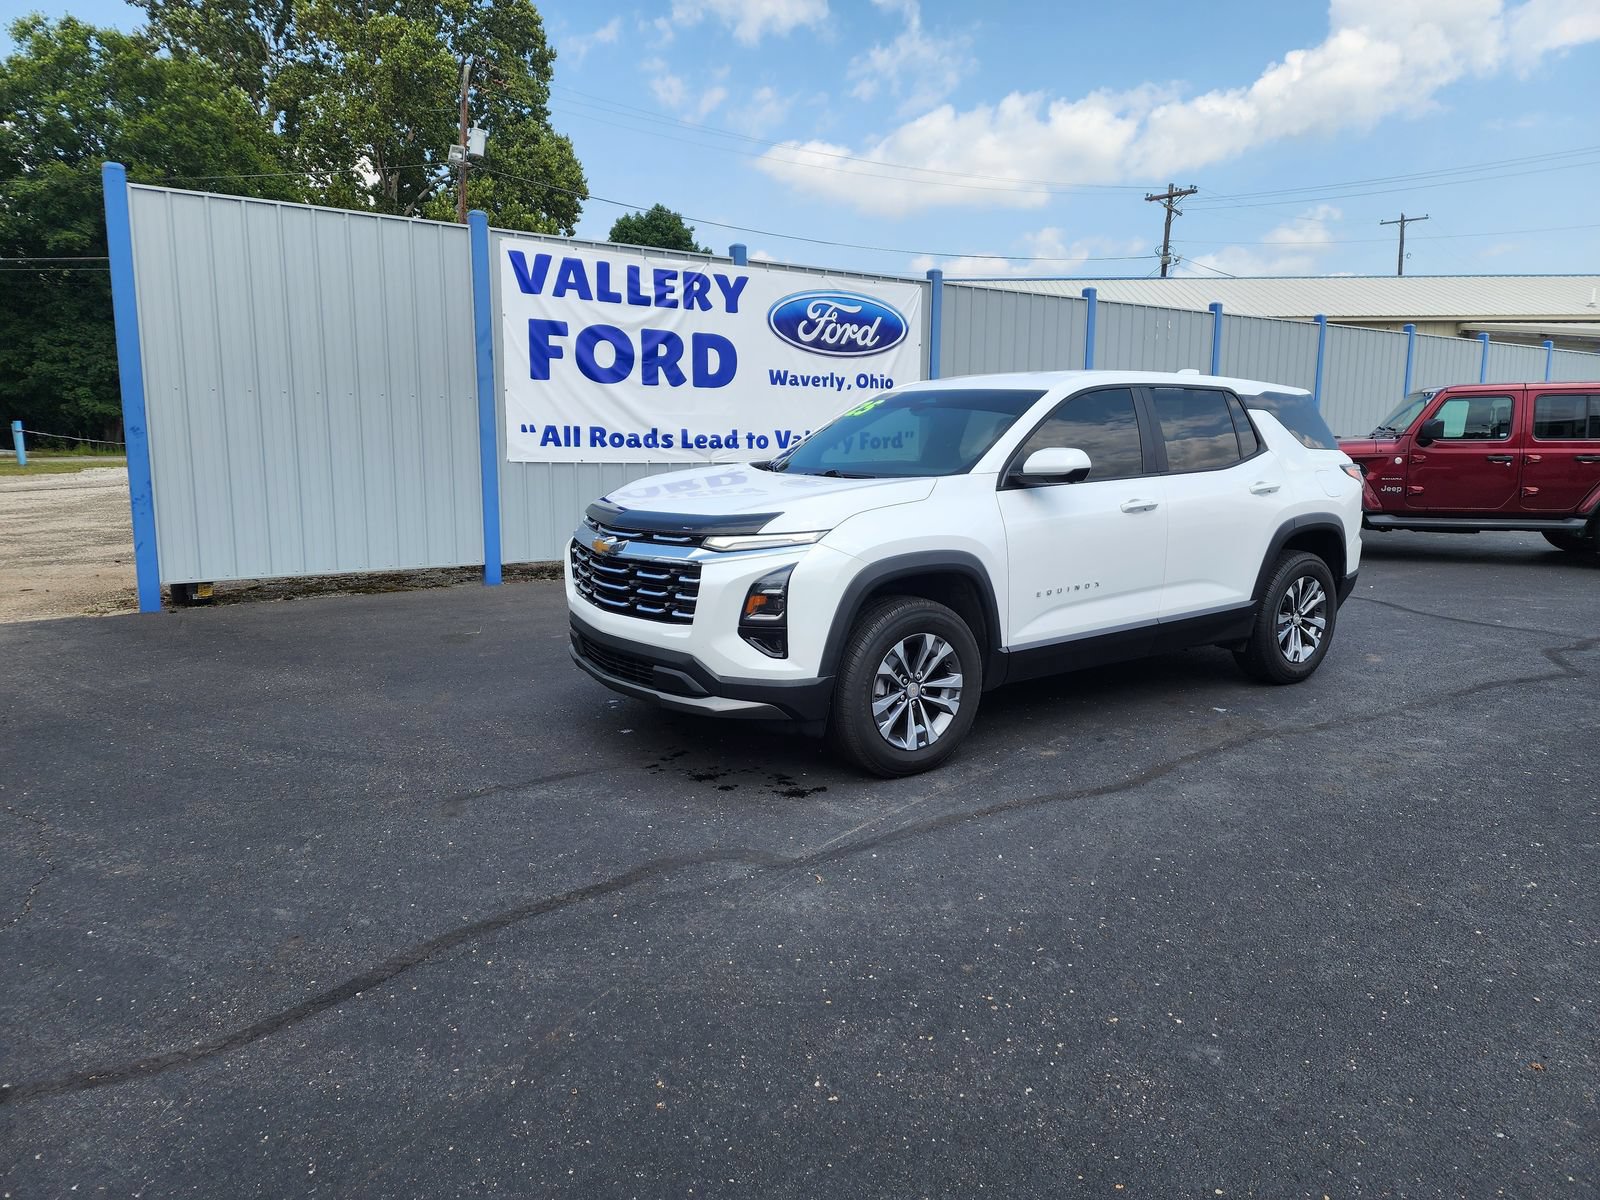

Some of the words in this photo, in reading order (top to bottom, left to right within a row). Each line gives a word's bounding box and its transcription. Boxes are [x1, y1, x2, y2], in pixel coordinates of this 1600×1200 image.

[507, 249, 749, 313] VALLERY
[797, 300, 882, 347] Ford
[528, 318, 738, 389] FORD
[768, 369, 852, 391] Waverly,
[855, 373, 894, 389] Ohio
[589, 426, 674, 449] Roads
[681, 428, 739, 449] Lead
[746, 432, 769, 449] to
[1380, 485, 1402, 493] Jeep
[1036, 582, 1100, 598] EQUINOX
